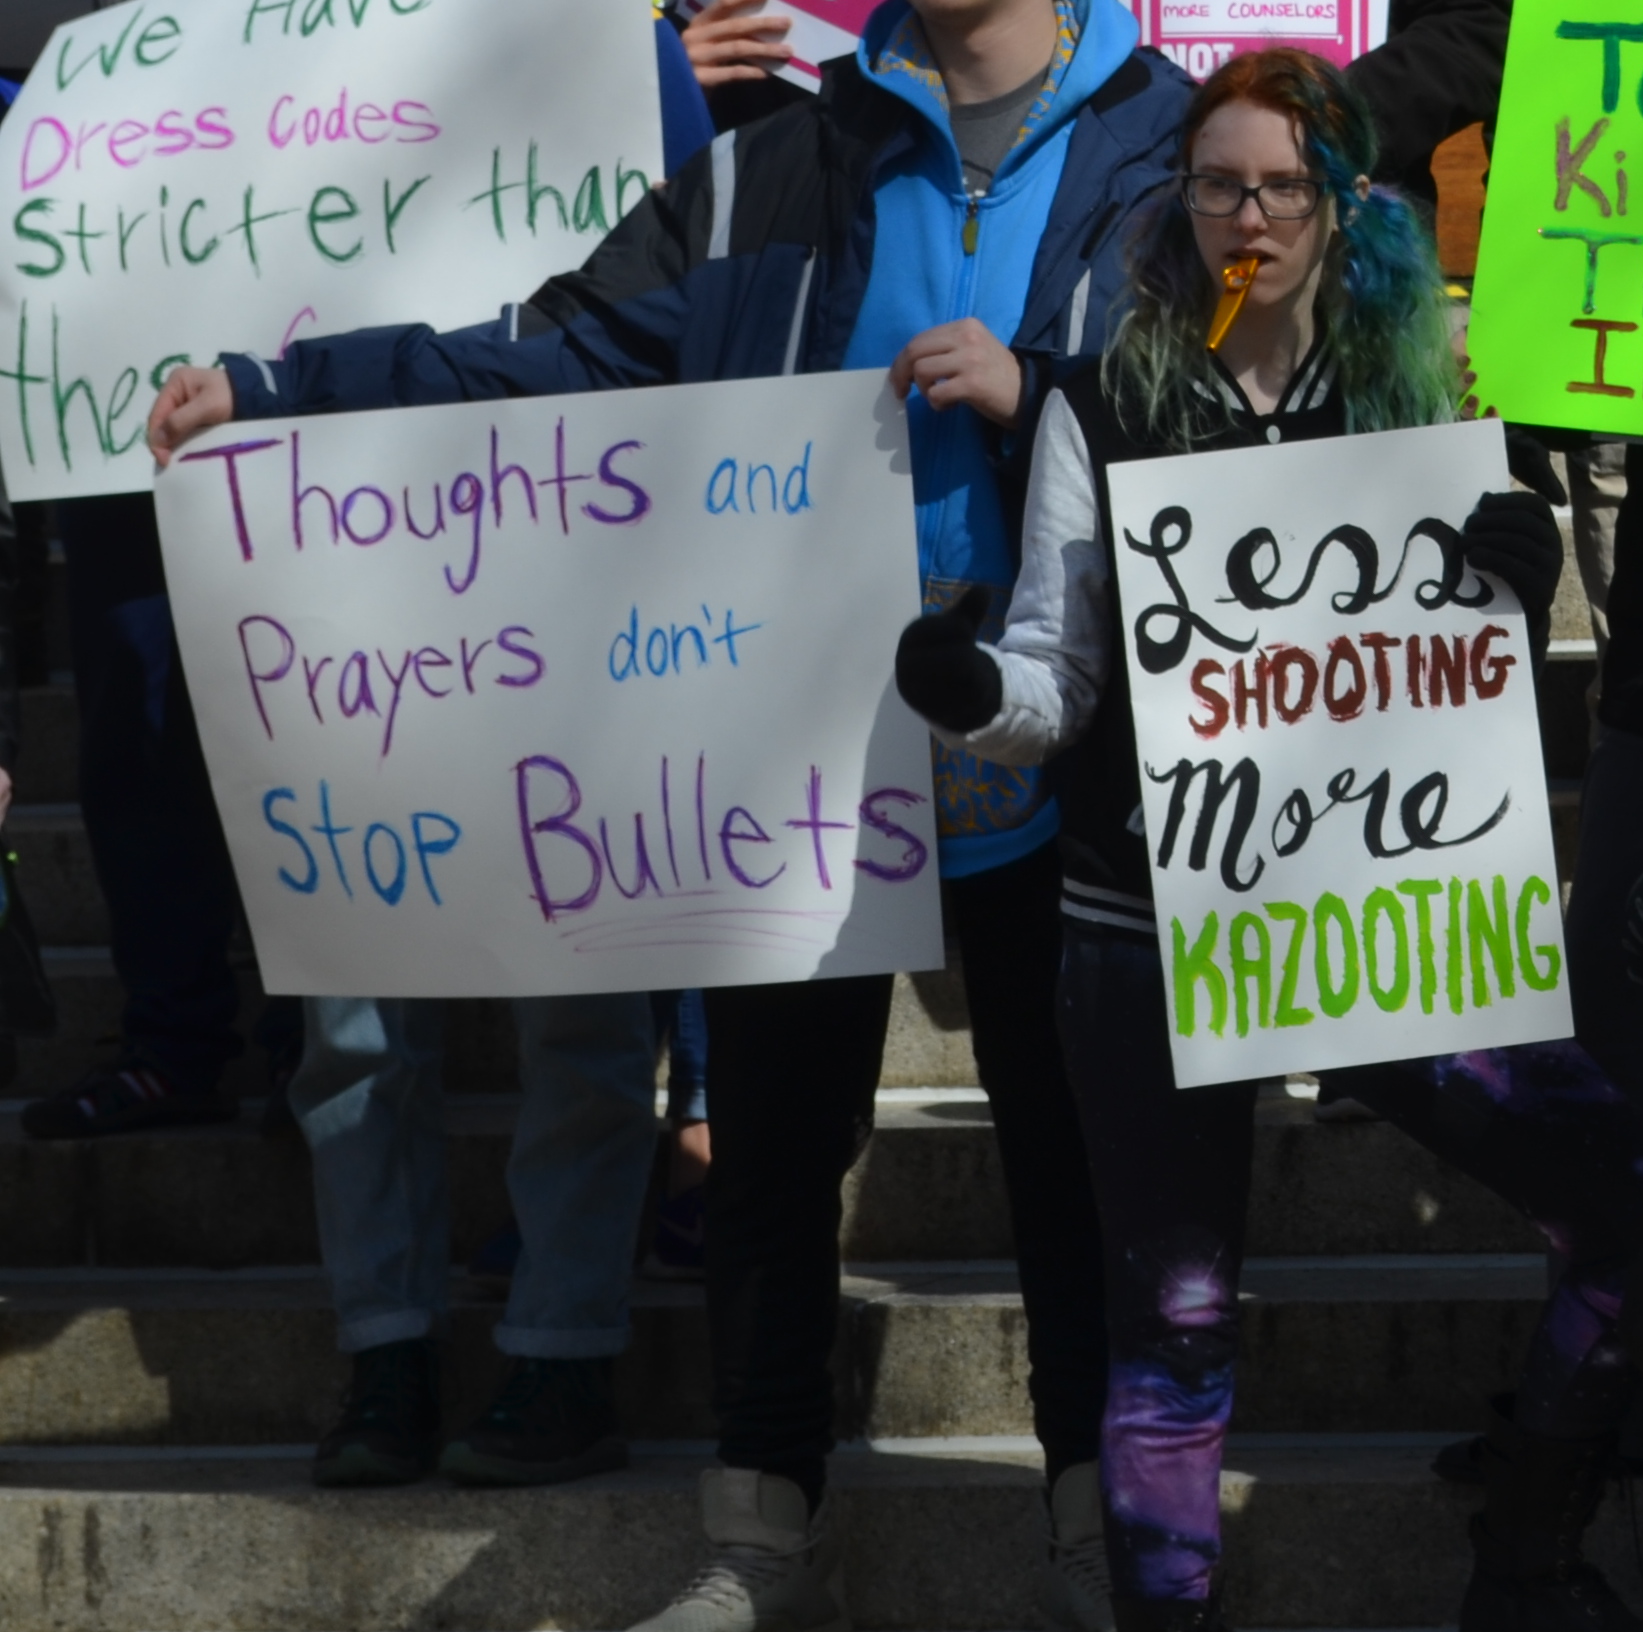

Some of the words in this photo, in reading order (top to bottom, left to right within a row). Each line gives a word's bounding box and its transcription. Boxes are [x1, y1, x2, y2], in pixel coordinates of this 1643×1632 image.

[57, 5, 182, 93] We
[1163, 3, 1210, 20] MORE
[1228, 2, 1337, 20] COUNSELORS
[20, 105, 236, 192] Dress
[463, 137, 651, 246] than
[179, 414, 654, 595] Thoughts
[704, 441, 815, 518] and
[1122, 505, 1496, 675] Less
[237, 613, 546, 760] Prayers
[608, 603, 763, 683] don't
[1187, 623, 1519, 740] SHOOTING
[509, 749, 929, 924] Bullets
[1144, 755, 1514, 894] More
[1169, 874, 1562, 1039] KAZOOTING
